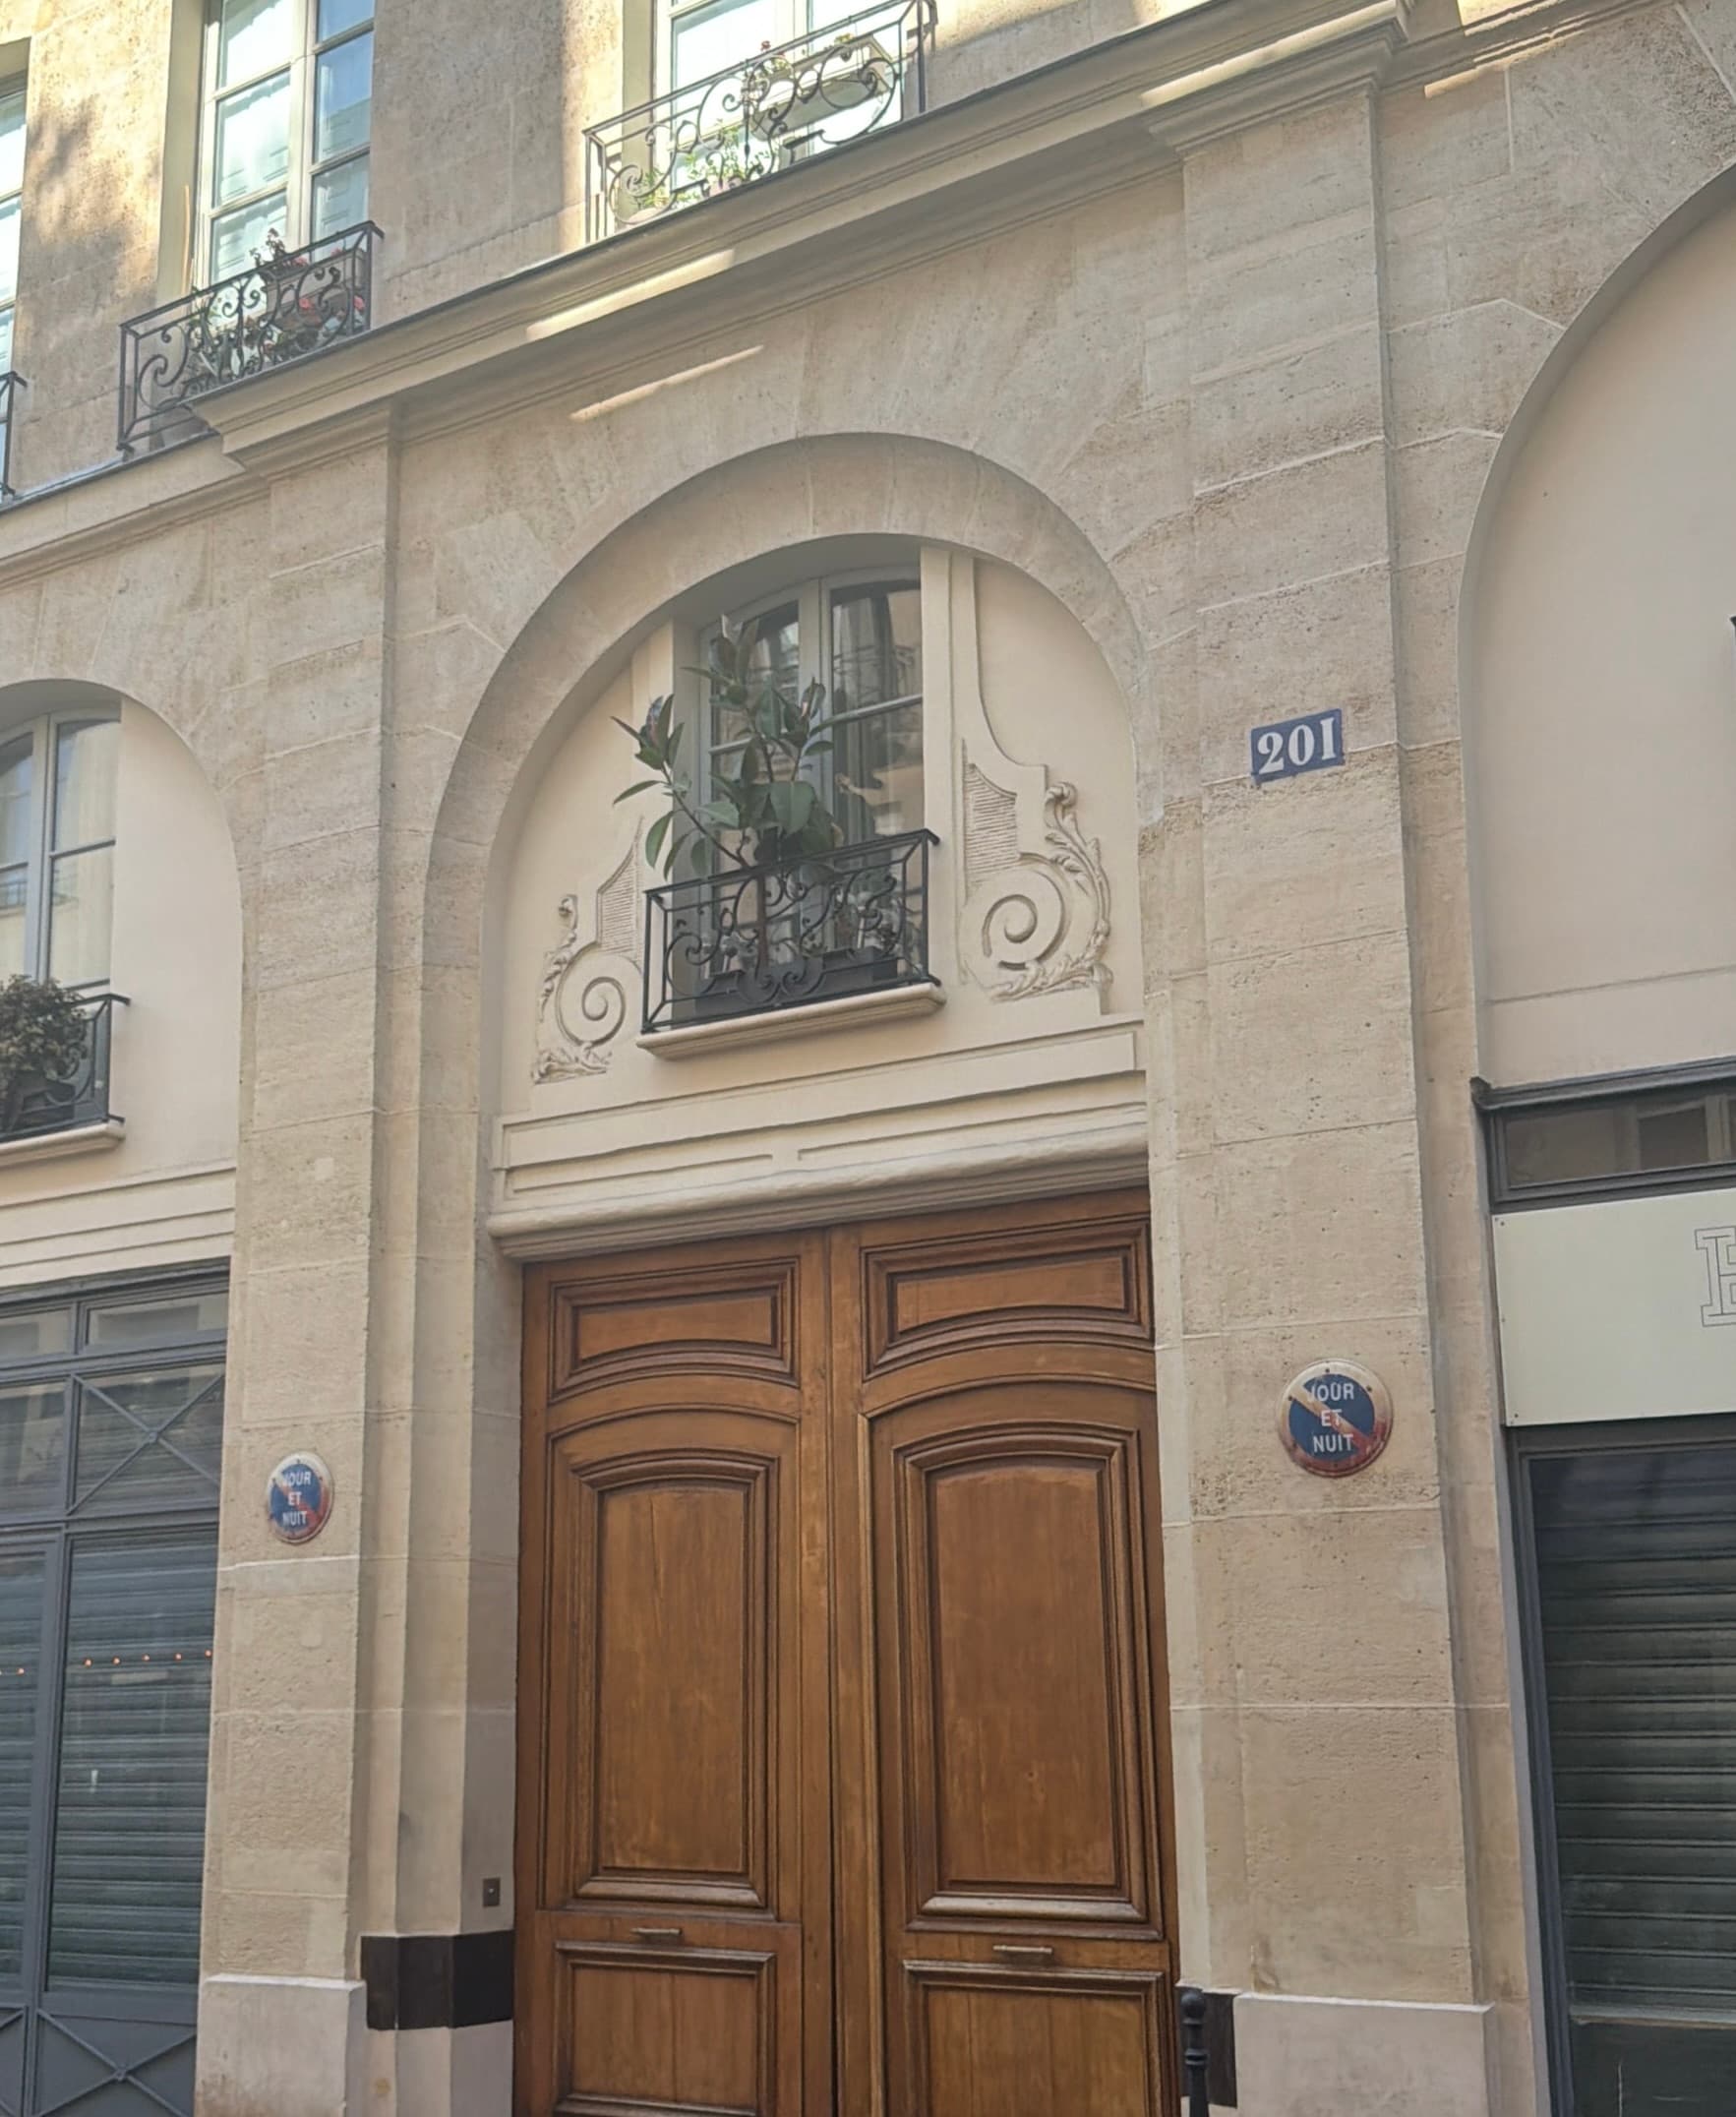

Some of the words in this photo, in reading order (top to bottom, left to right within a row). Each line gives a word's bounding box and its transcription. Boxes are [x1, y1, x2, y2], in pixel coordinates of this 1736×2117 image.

[1257, 716, 1337, 775] 201
[1321, 1408, 1343, 1427] ET
[1312, 1433, 1354, 1453] NUIT
[287, 1490, 303, 1506] ET
[282, 1510, 308, 1527] NUIT
